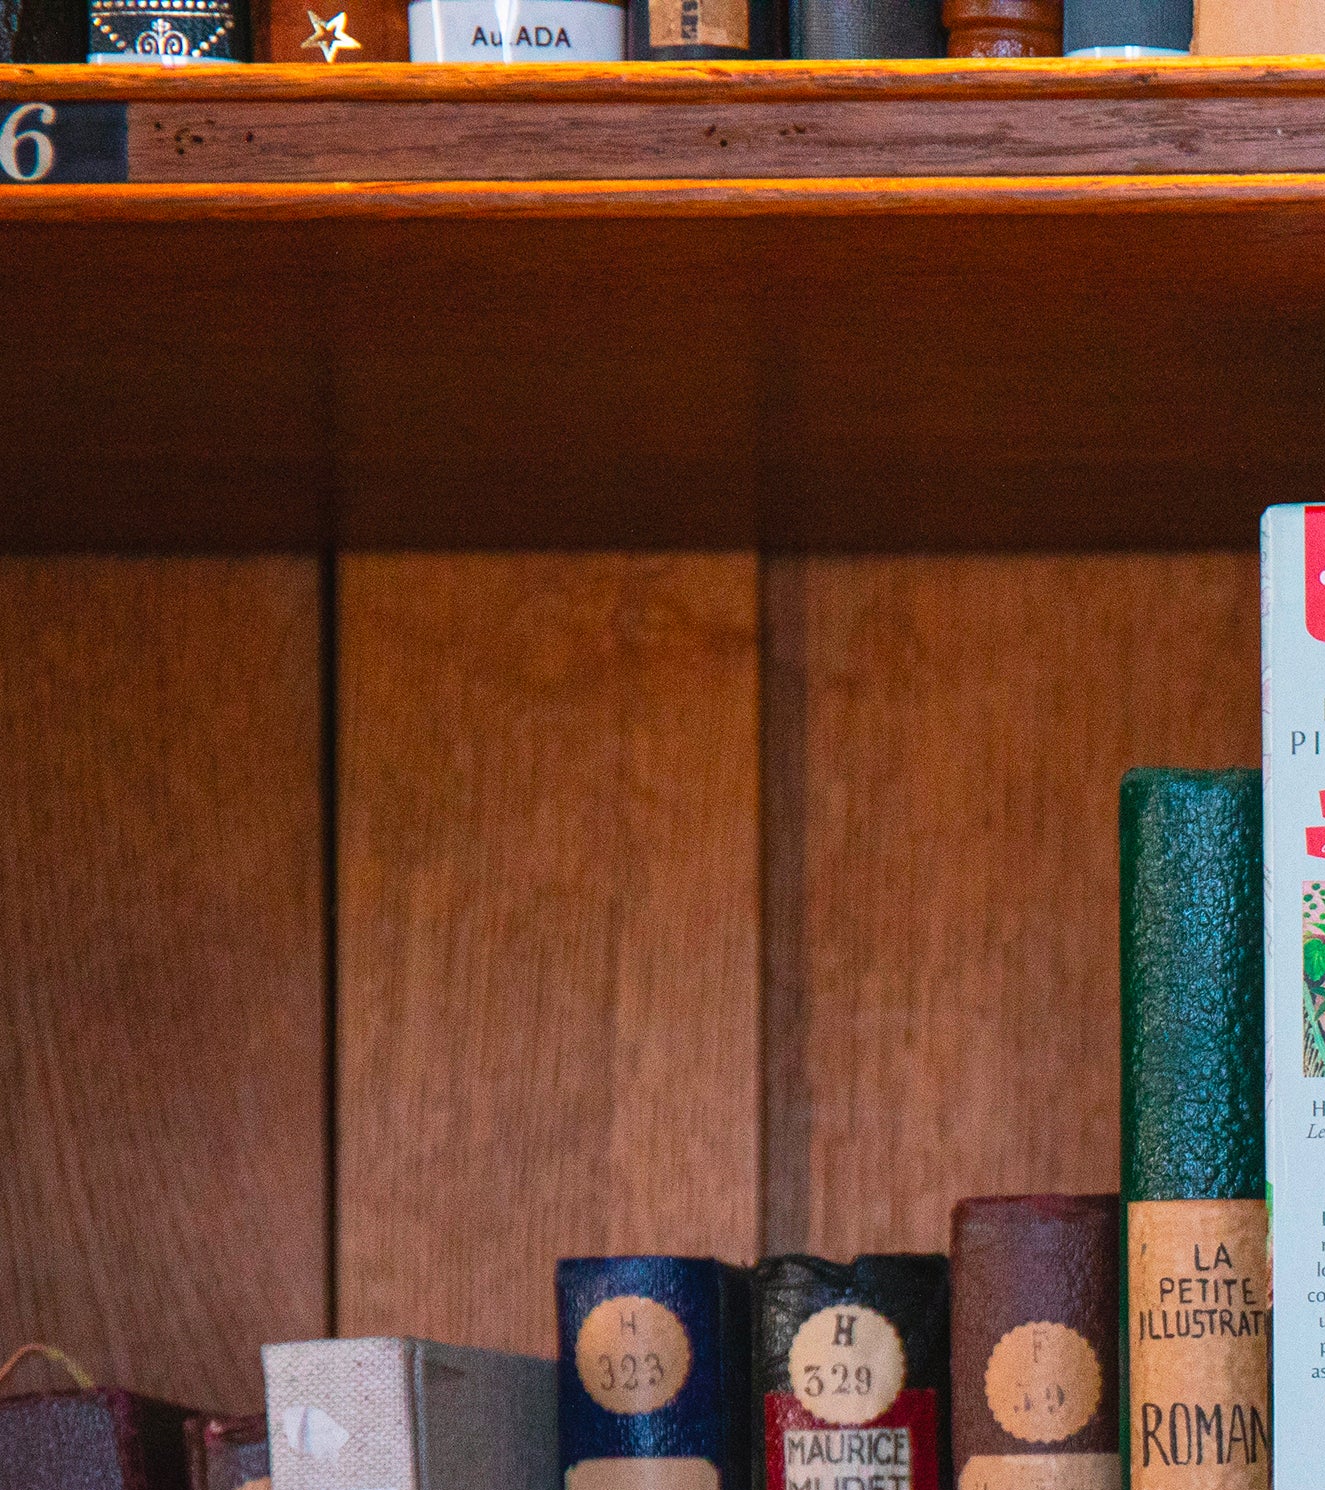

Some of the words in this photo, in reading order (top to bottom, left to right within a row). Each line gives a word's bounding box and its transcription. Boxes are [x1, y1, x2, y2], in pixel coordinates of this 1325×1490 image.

[515, 26, 572, 48] ADA
[0, 102, 57, 181] 6
[1193, 1242, 1233, 1272] LA
[1159, 1277, 1255, 1305] PETITE
[618, 1310, 638, 1336] H
[830, 1312, 858, 1347] H
[598, 1353, 665, 1392] 323
[803, 1363, 872, 1398] 329
[787, 1433, 911, 1466] MAURICE
